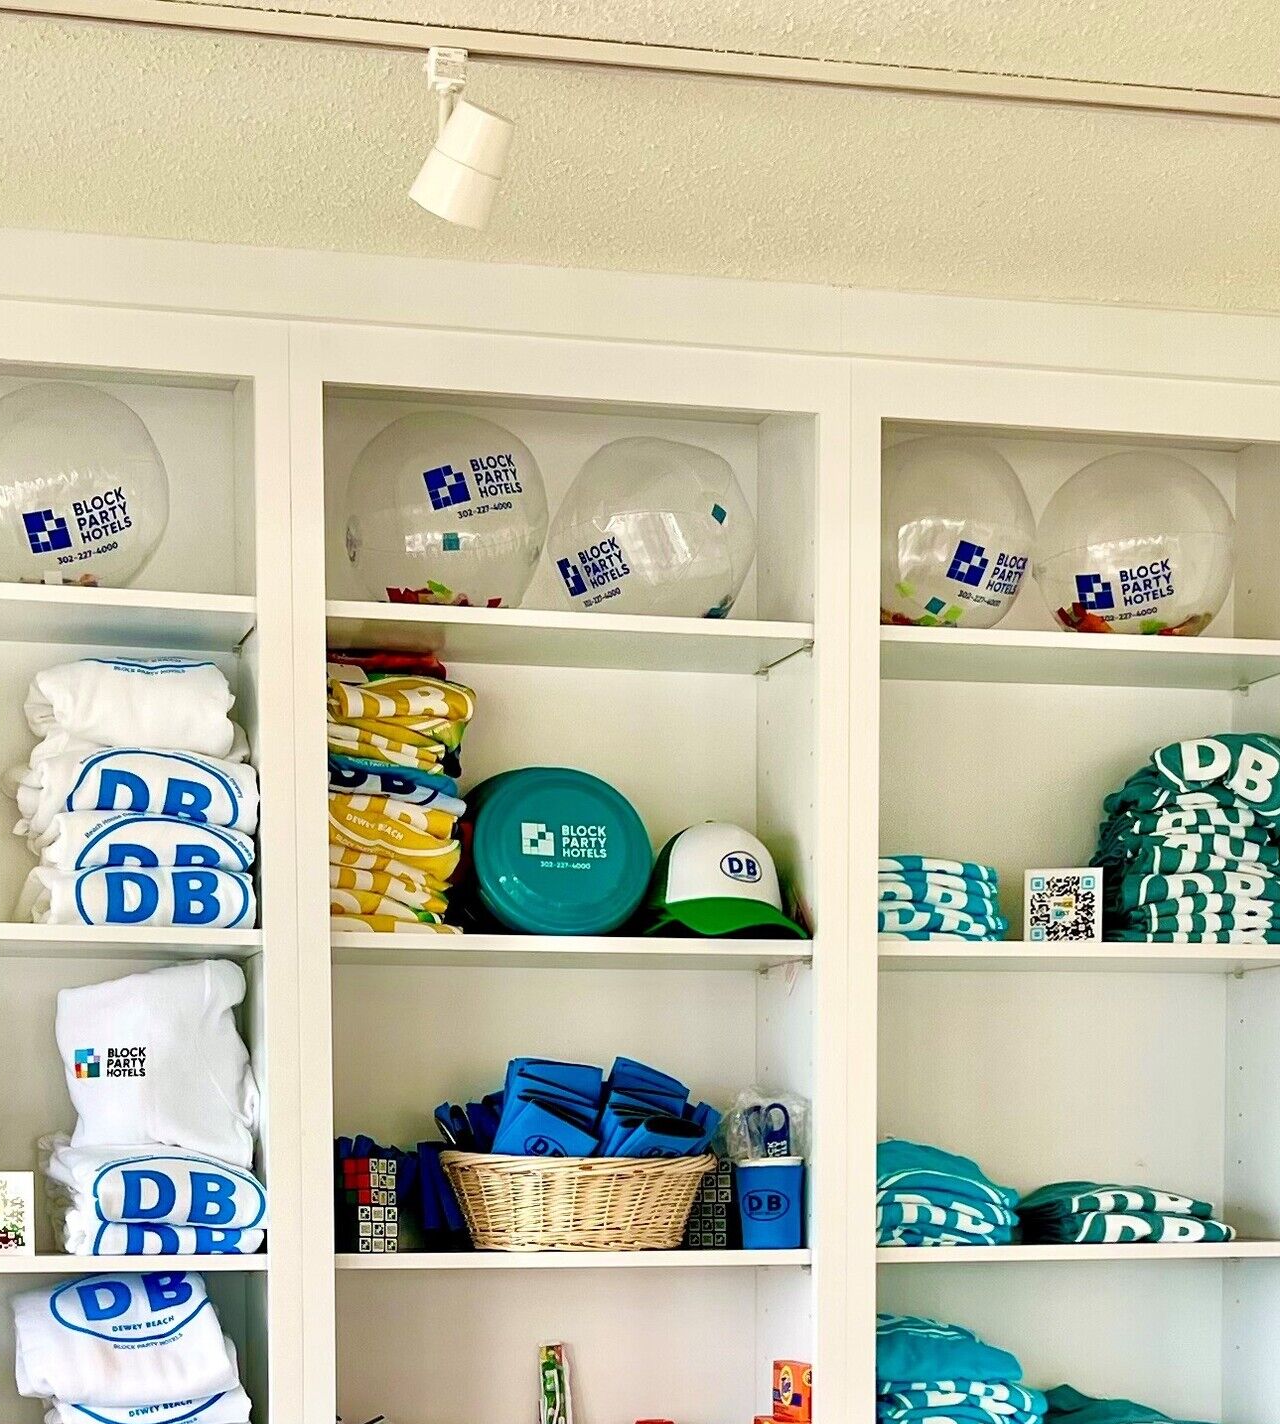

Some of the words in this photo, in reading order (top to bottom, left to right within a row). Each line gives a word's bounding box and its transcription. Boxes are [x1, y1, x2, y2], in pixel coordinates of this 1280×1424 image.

[470, 454, 515, 472] BLOCK
[474, 468, 519, 486] PARTY
[478, 481, 523, 499] HOTELS
[72, 487, 126, 516] BLOCK
[457, 501, 513, 519] 302-227-4000
[76, 501, 127, 531] PARTY
[81, 516, 132, 544] HOTELS
[56, 541, 119, 565] 302-227-4000
[577, 537, 621, 565] BLOCK
[583, 550, 625, 578] PARTY
[996, 552, 1029, 570] BLOCK
[590, 564, 631, 589] HOTELS
[992, 566, 1025, 582] PARTY
[1119, 558, 1173, 583] BLOCK
[985, 579, 1018, 596] HOTELS
[1121, 572, 1174, 596] PARTY
[1124, 585, 1175, 607] HOTELS
[561, 824, 607, 837] BLOCK
[562, 837, 607, 849] PARTY
[562, 848, 608, 859] HOTELS
[727, 857, 758, 876] DB
[104, 871, 221, 925] DB
[107, 1046, 146, 1058] BLOCK
[106, 1058, 146, 1068] PARTY
[106, 1068, 146, 1077] HOTELS
[121, 1170, 236, 1225] DB
[747, 1195, 783, 1212] DB
[76, 1271, 193, 1322] DB
[111, 1322, 143, 1332] DEWEY
[146, 1315, 175, 1329] BEACH
[128, 1404, 161, 1418] DEWEY
